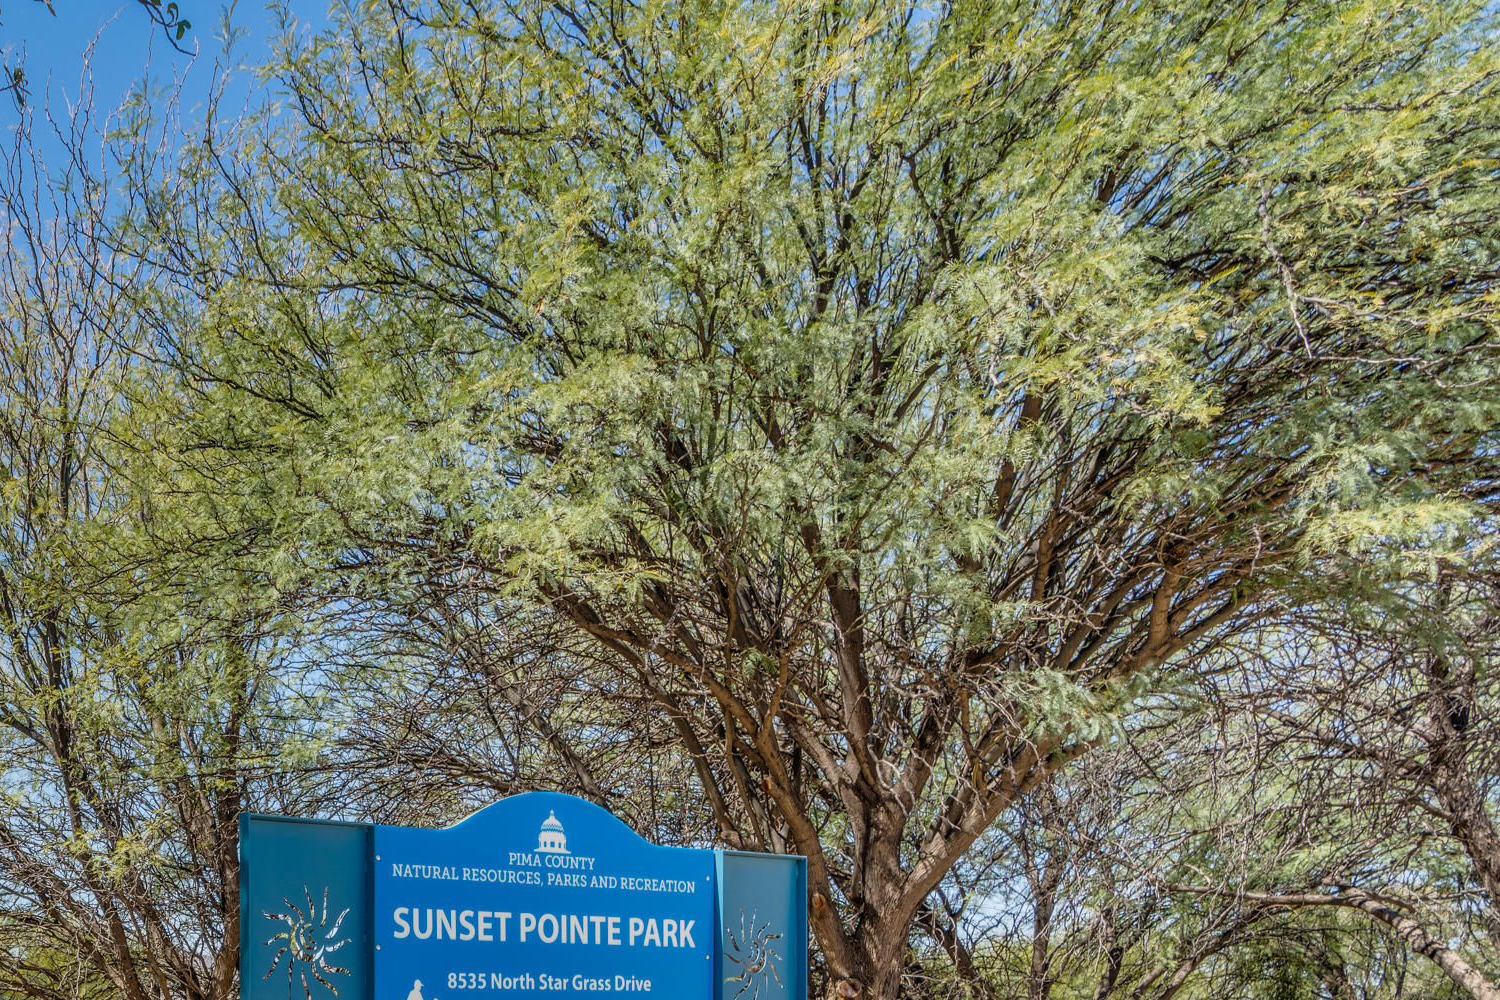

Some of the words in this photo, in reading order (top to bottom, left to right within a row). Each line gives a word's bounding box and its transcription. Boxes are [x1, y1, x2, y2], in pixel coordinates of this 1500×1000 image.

[509, 851, 543, 866] PIMA
[545, 853, 594, 870] COUNTY
[393, 864, 458, 880] NATURAL
[463, 868, 543, 886] RESOURCES,
[548, 873, 587, 887] PARKS
[590, 876, 617, 888] AND
[621, 877, 695, 893] RECREATION
[394, 907, 511, 941] SUNSET
[520, 913, 621, 945] POINTE
[629, 918, 695, 948] PARK
[448, 973, 486, 989] 8535
[491, 973, 535, 989] North
[540, 974, 568, 990] Star
[572, 975, 611, 991] Grass
[615, 976, 651, 991] Drive
